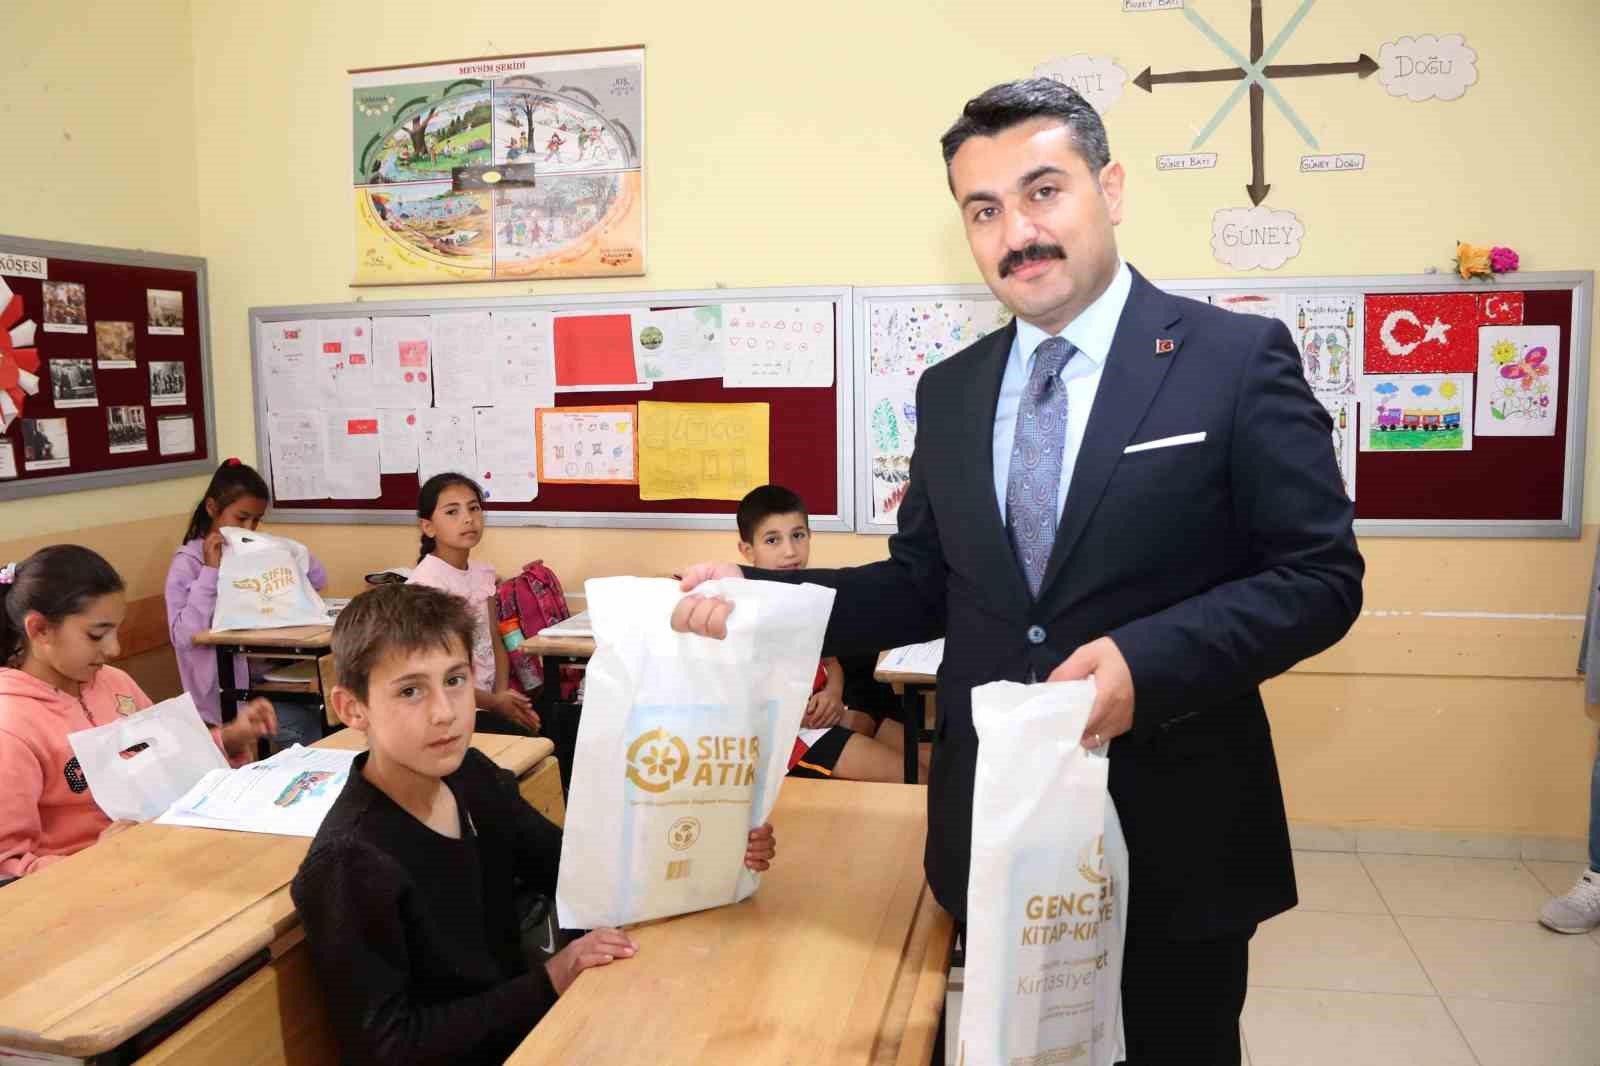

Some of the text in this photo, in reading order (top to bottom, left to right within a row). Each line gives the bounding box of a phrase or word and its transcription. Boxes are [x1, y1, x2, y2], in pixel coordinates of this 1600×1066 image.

[459, 60, 527, 75] MEVSİM ŞERİDİ
[1393, 55, 1453, 78] DOĞU
[1223, 223, 1293, 247] GÜNEY
[696, 735, 761, 761] SIFIR
